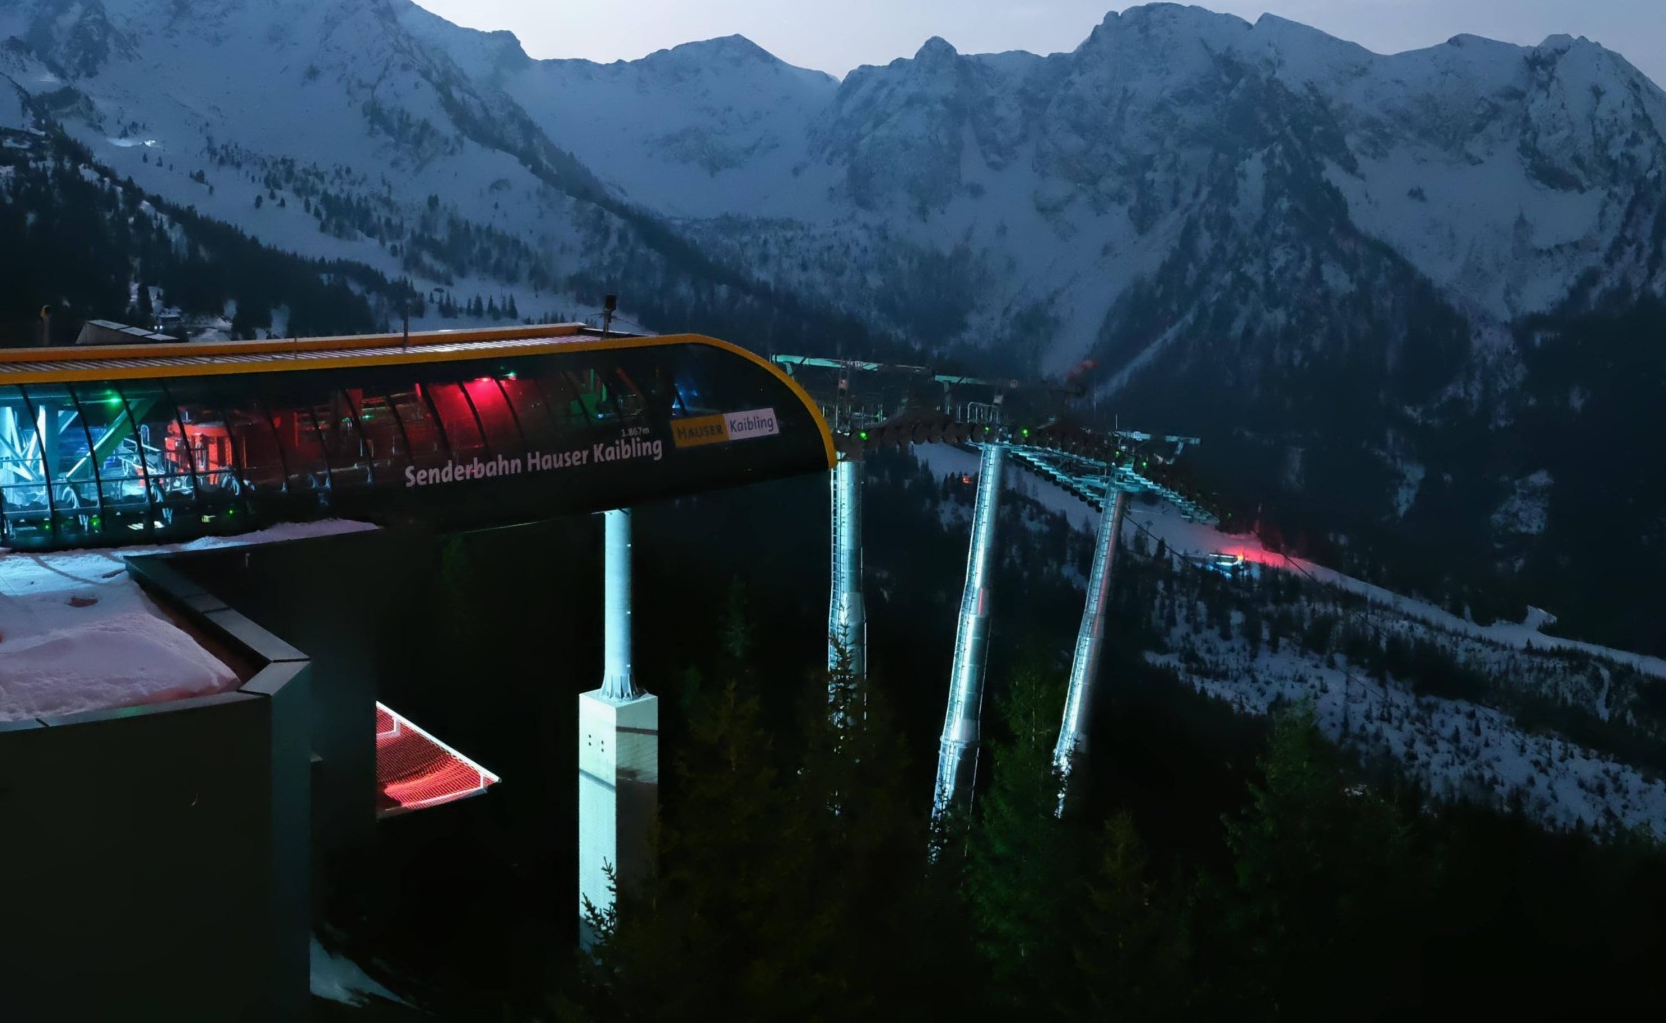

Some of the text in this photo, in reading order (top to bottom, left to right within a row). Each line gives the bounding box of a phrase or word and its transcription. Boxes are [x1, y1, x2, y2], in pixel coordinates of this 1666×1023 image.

[676, 416, 774, 439] HAUSER Kaibling
[405, 437, 663, 488] Senderbahn Hauser Kaibling
